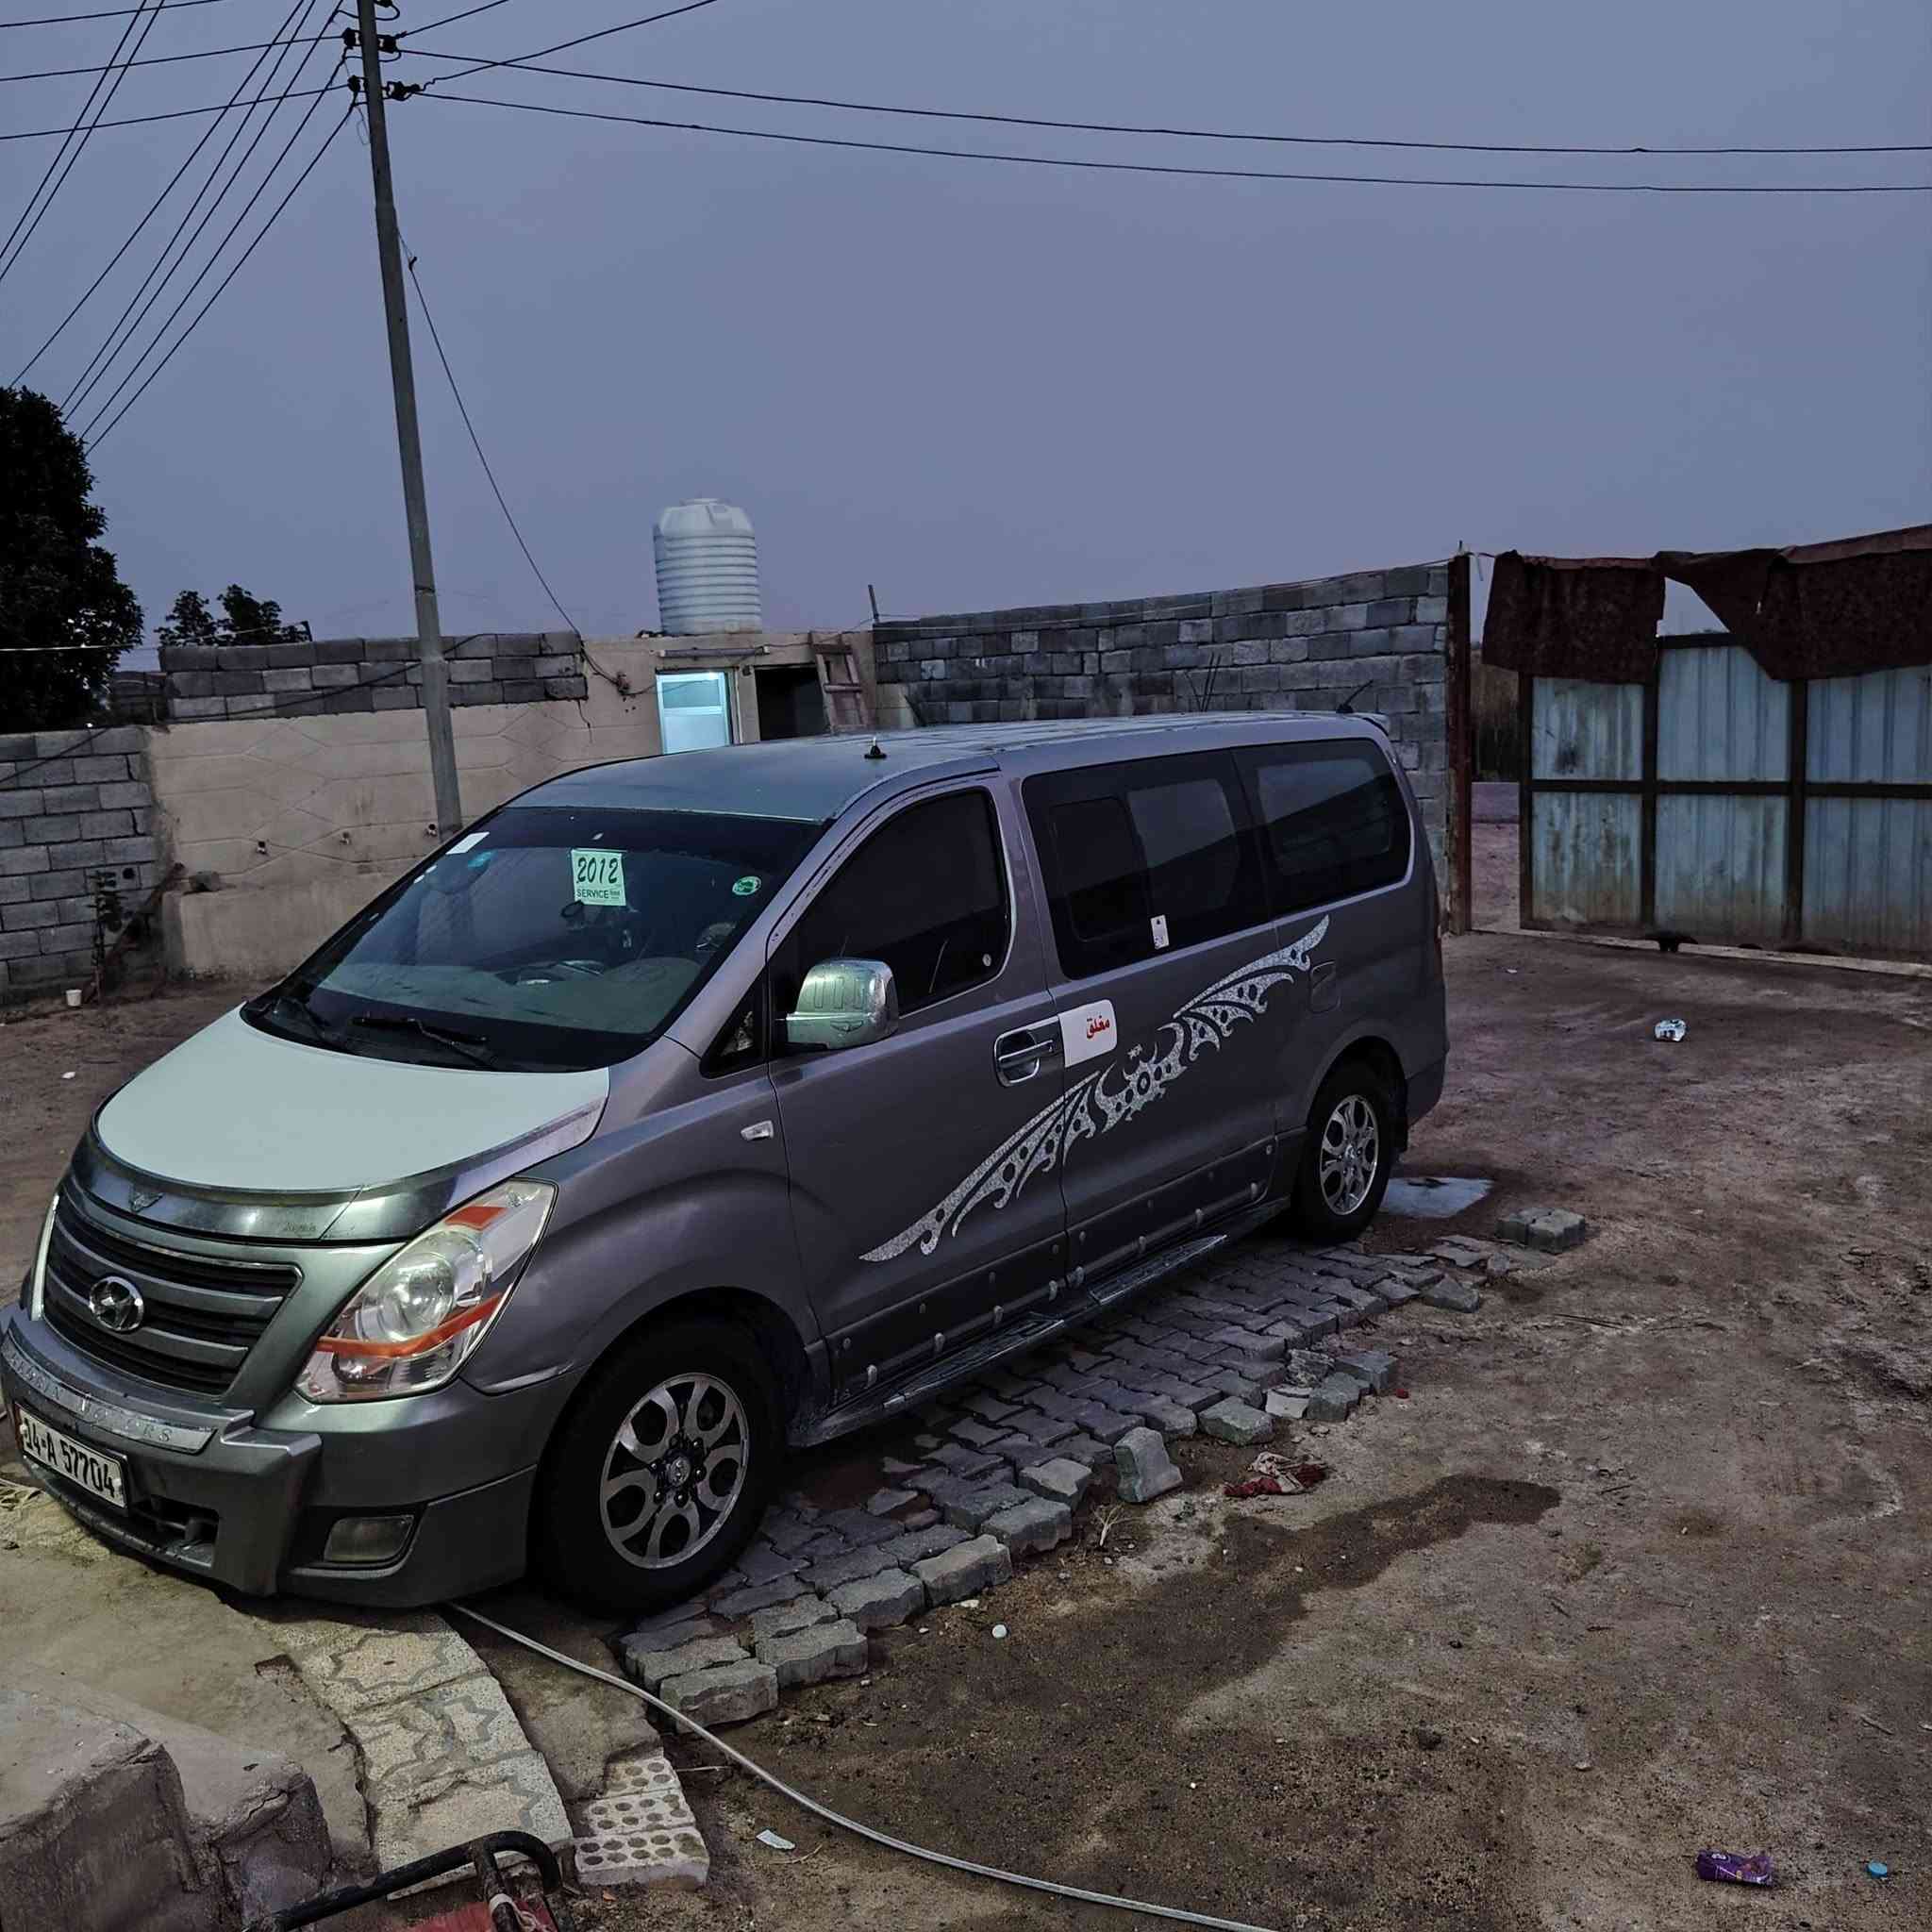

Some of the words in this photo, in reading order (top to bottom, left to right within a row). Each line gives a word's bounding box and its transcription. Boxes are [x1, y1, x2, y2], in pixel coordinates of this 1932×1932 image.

[577, 857, 619, 884] 2012
[575, 889, 609, 899] SERVICE
[1086, 1015, 1110, 1039] مغلق
[59, 1439, 115, 1498] 57704
